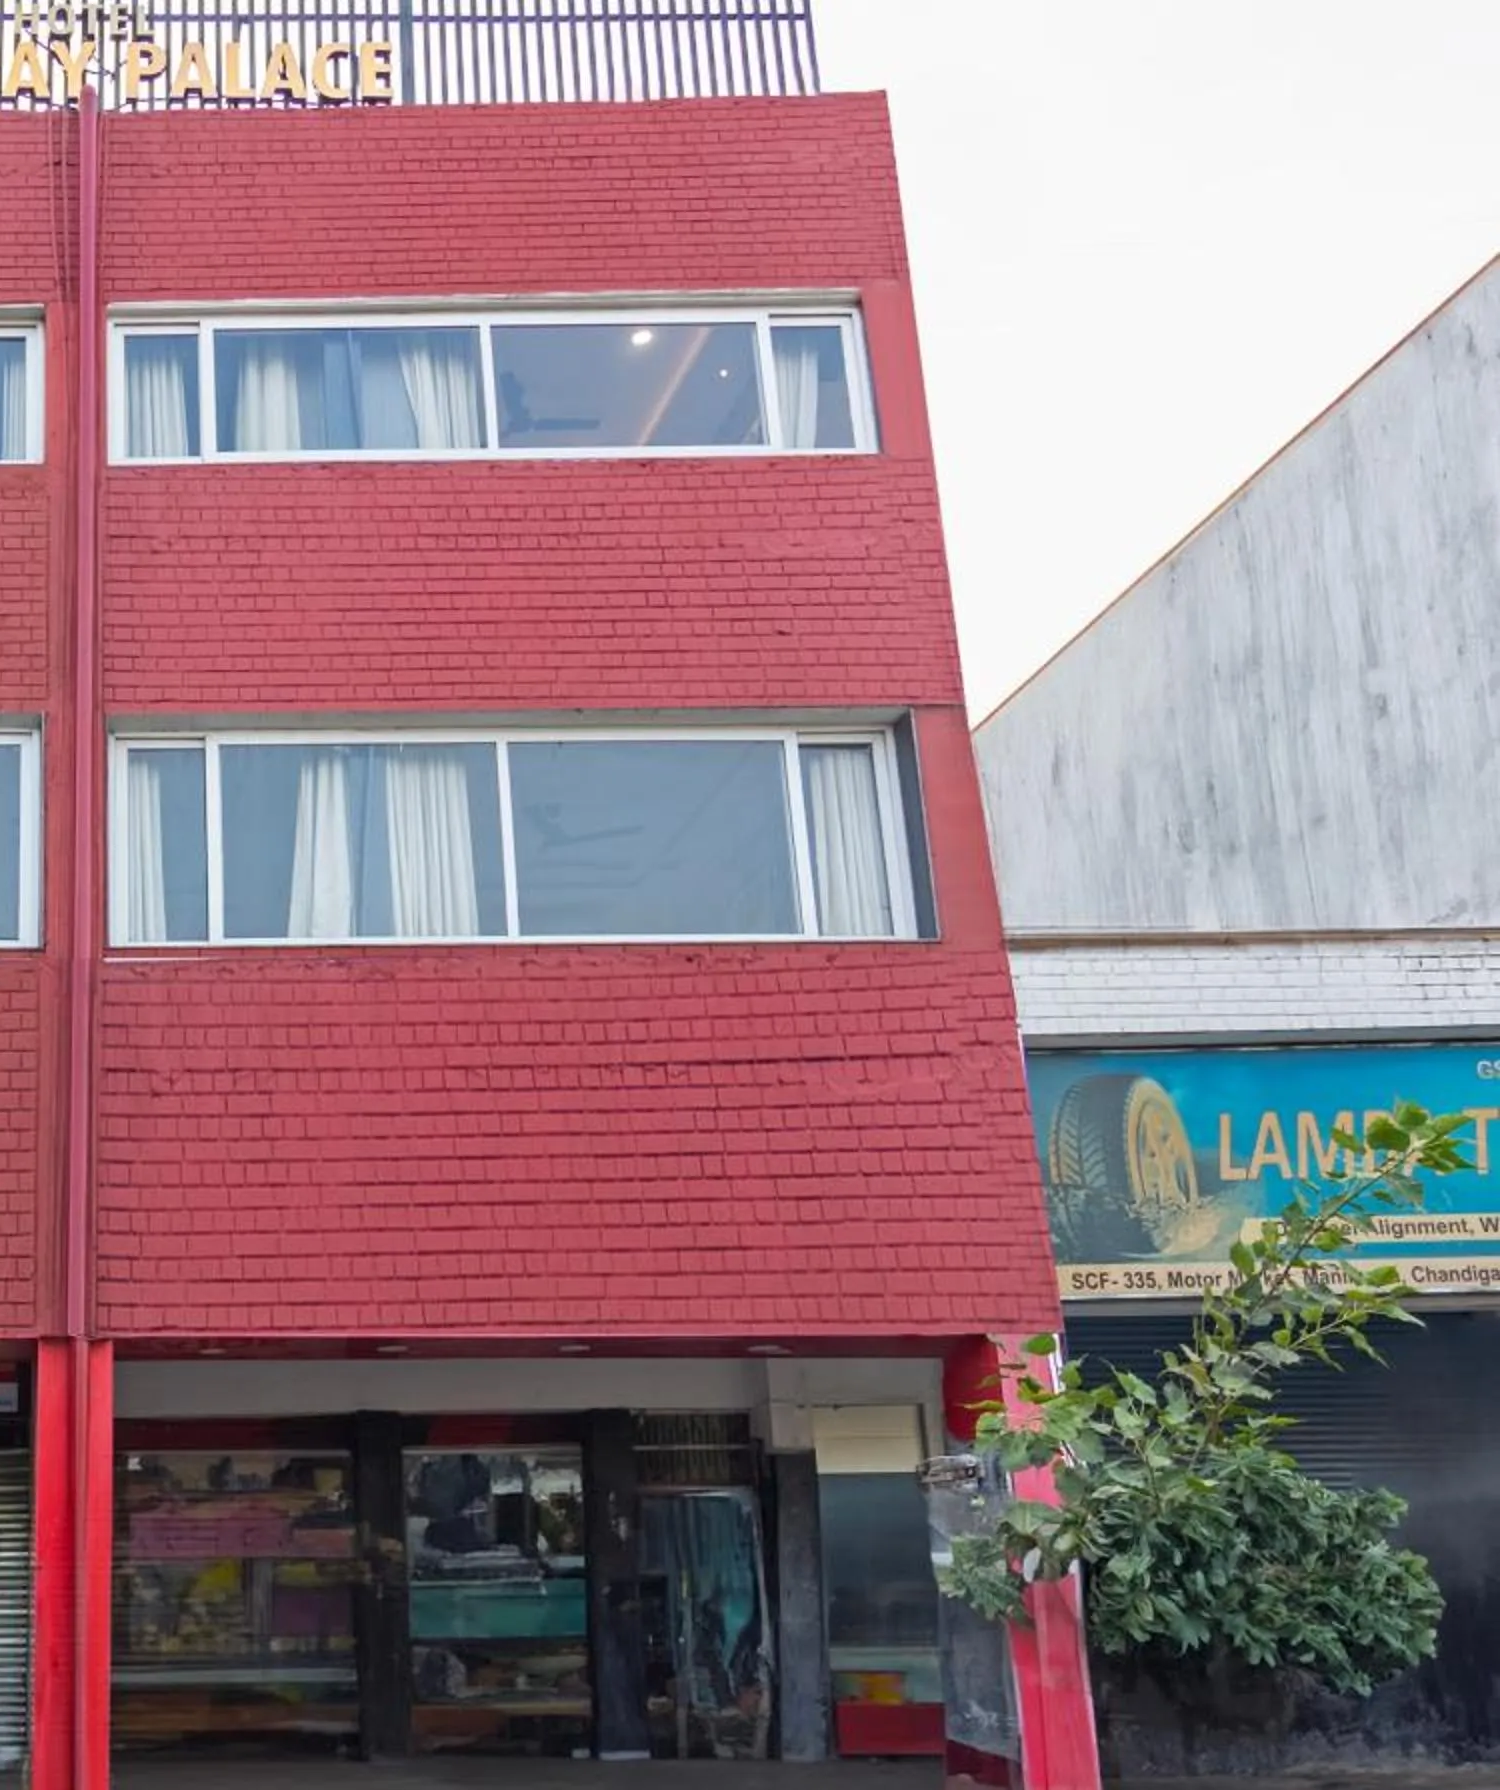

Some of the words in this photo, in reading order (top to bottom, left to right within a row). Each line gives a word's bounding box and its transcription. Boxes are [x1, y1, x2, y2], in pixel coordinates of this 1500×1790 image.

[14, 2, 155, 36] HOTEL
[125, 41, 394, 100] PALACE
[1219, 1110, 1446, 1181] LAM
[1071, 1271, 1118, 1290] SCF-
[1123, 1271, 1163, 1291] 335,
[1167, 1270, 1223, 1288] Motor
